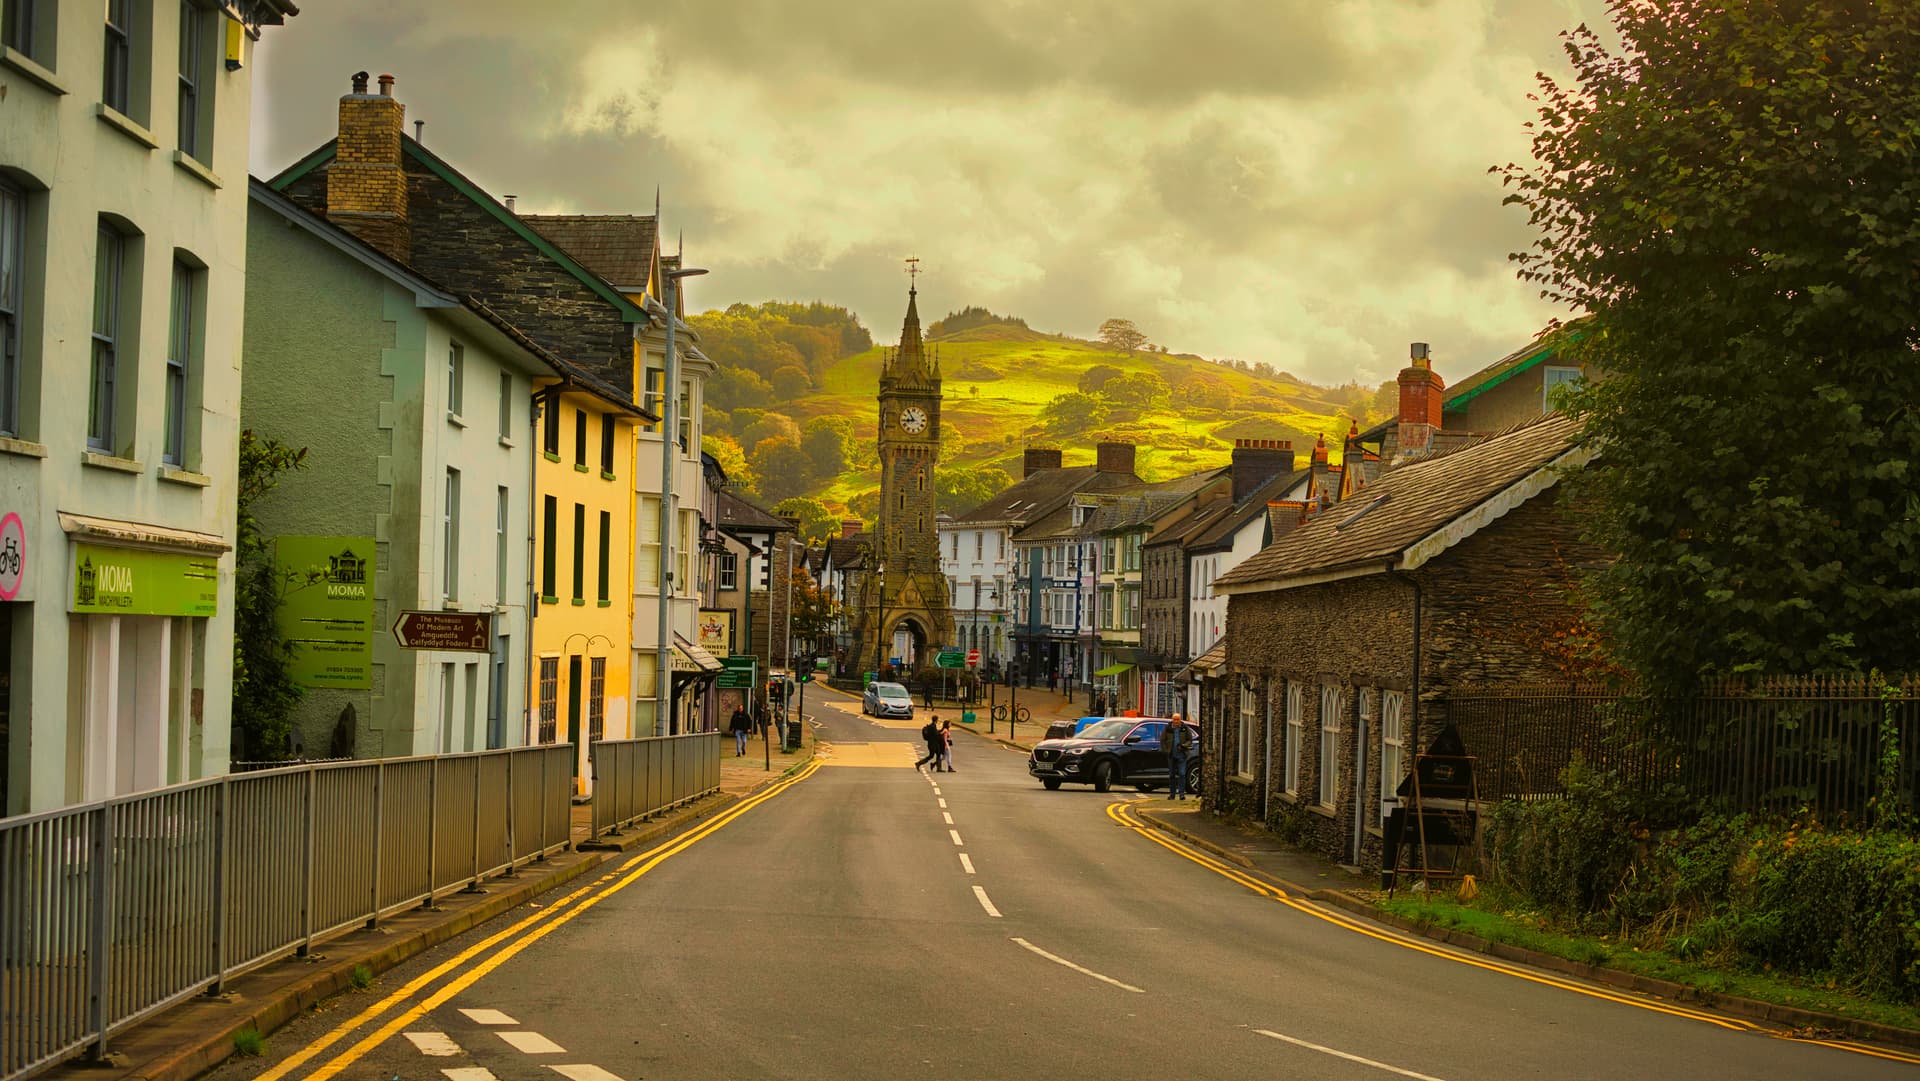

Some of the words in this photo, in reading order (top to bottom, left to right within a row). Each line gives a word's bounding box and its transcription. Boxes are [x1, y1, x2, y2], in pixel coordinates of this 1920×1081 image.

[99, 565, 133, 593] MOMA
[327, 585, 366, 596] MOMA
[434, 616, 462, 624] Museum
[421, 631, 458, 640] Amgueddfa
[675, 658, 696, 669] Fire
